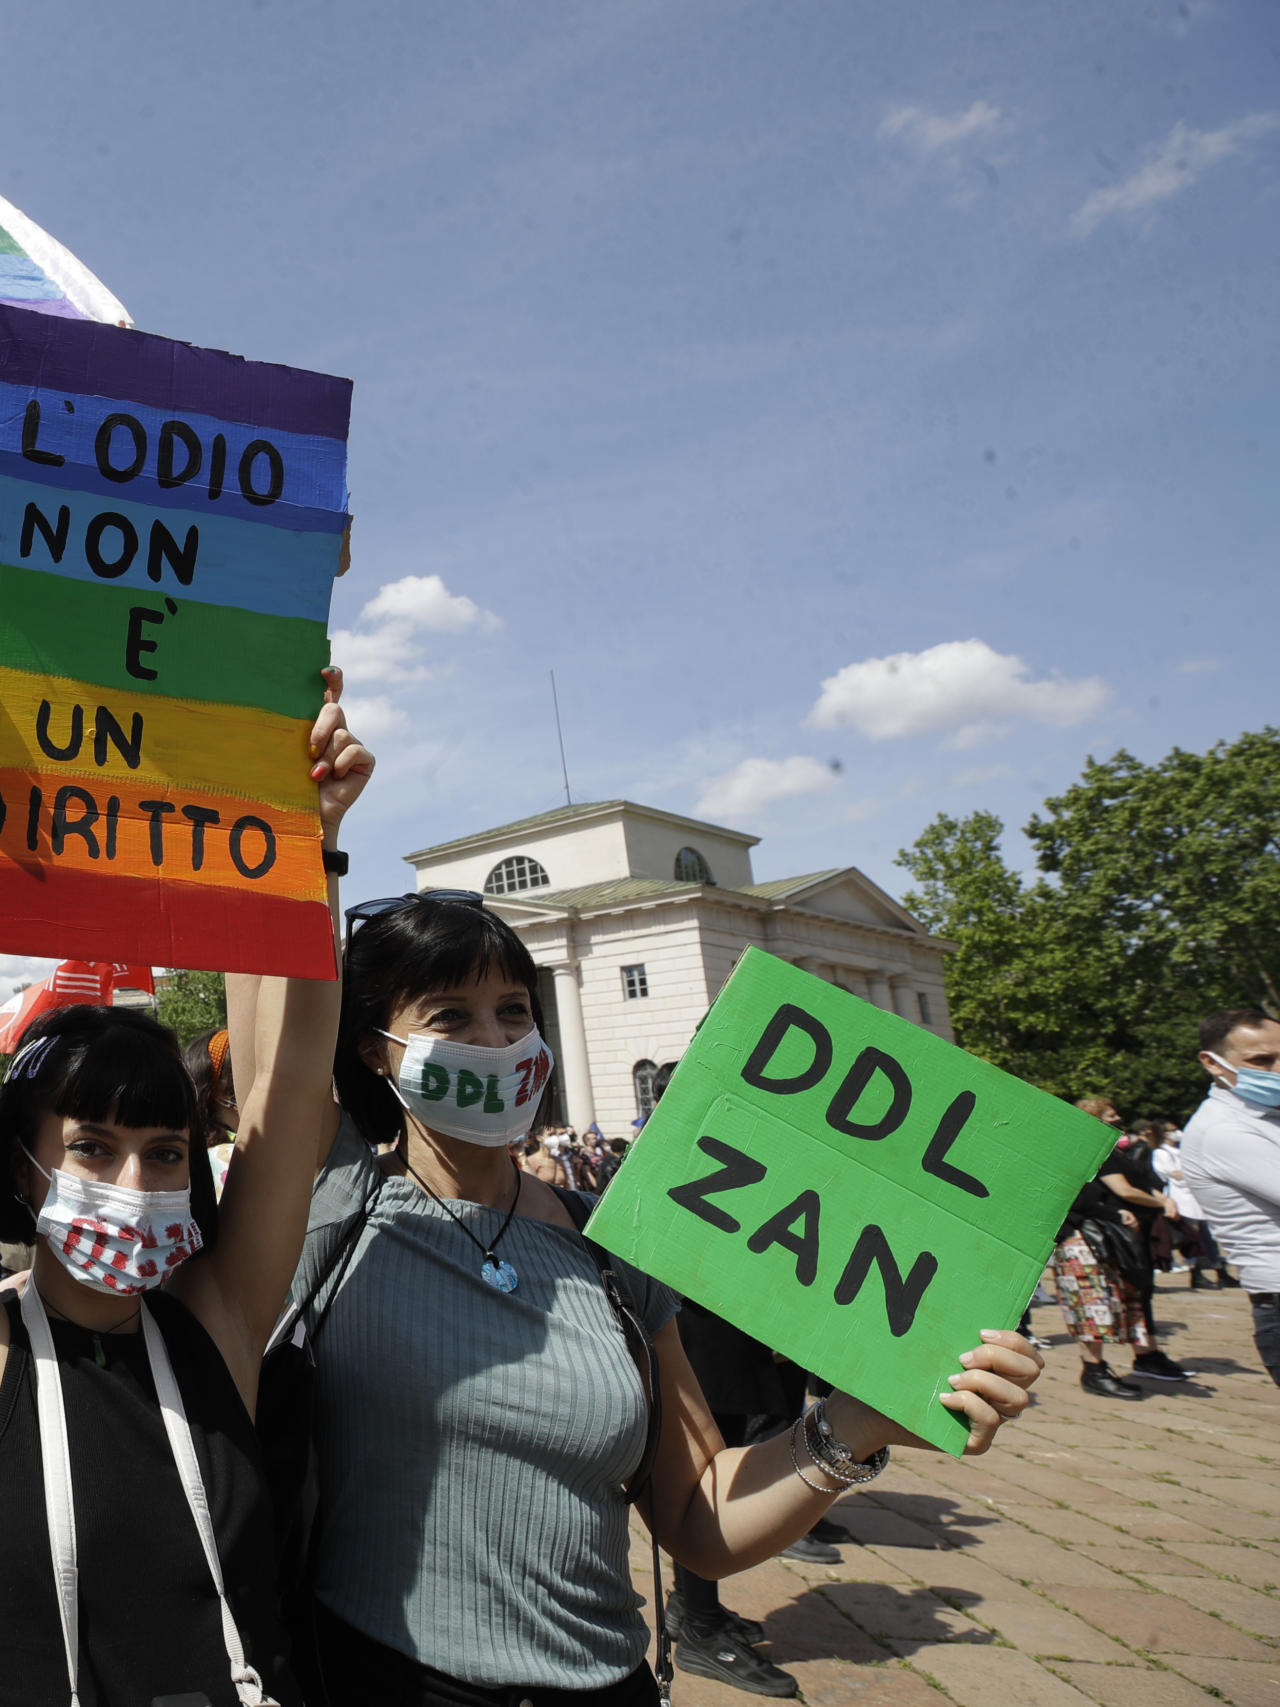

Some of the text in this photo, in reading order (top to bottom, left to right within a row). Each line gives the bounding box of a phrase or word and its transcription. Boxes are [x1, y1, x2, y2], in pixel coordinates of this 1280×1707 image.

[22, 399, 285, 507] L'ODIO
[20, 501, 200, 586] NON
[124, 596, 179, 682] È
[35, 699, 144, 770] UN
[421, 1062, 505, 1114] DDL
[740, 1003, 990, 1198] DDL
[667, 1136, 938, 1338] ZAN
